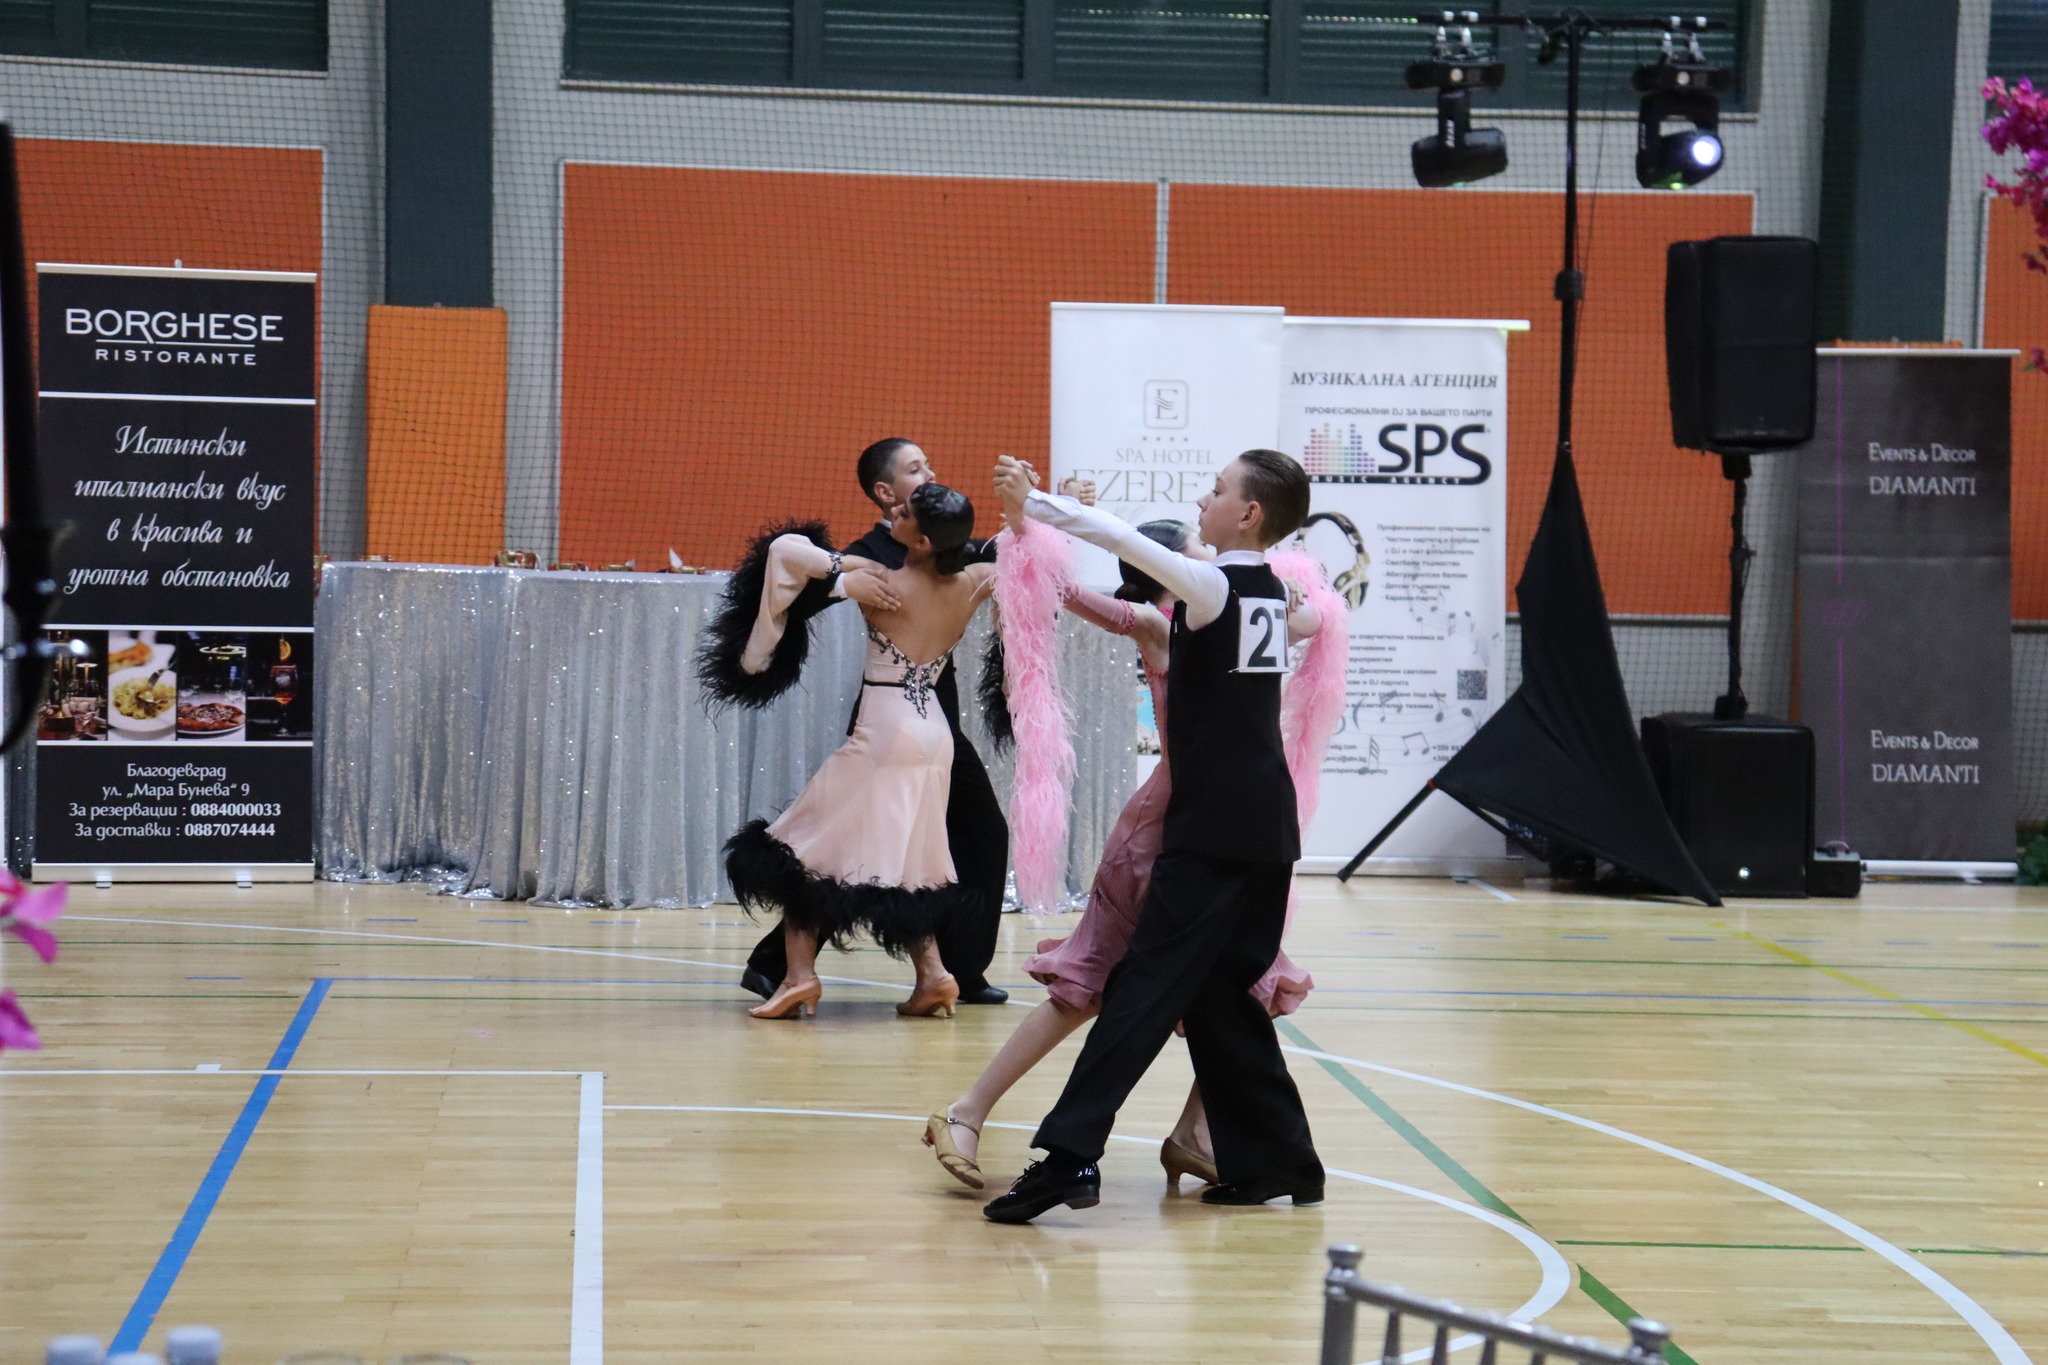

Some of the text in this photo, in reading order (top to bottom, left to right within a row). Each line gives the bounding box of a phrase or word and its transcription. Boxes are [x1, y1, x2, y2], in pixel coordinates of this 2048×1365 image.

[65, 308, 284, 344] BORGHESE
[95, 348, 257, 366] RISTORANTE
[1290, 372, 1498, 389] МУЗИКАЛНА АГЕНЦИЯ
[1305, 407, 1390, 416] ПРОФЕСИОНАЛНИ
[1392, 408, 1403, 416] DJ
[1420, 409, 1460, 417] ВАШЕТО
[1462, 409, 1493, 417] ПАРТИ
[114, 425, 247, 457] Истински
[1116, 448, 1215, 464] SPA HOTEL
[1378, 423, 1492, 485] SPS
[1918, 448, 1928, 461] &
[1312, 475, 1367, 483] MUSIC
[1869, 476, 1977, 496] DIAMANTI
[74, 471, 286, 510] италиански вкус
[107, 513, 253, 552] в красива и
[63, 558, 290, 595] уютна обстановка
[1921, 736, 1931, 750] &
[127, 763, 226, 781] Благодевград
[1871, 763, 1980, 784] DIAMANTI
[102, 785, 122, 801] ул.
[241, 784, 250, 797] 9
[69, 803, 87, 816] За
[91, 803, 177, 820] резервации
[190, 804, 281, 816] 0884000033
[75, 823, 93, 836] За
[96, 822, 171, 841] доставки
[184, 823, 275, 836] 0887074444
